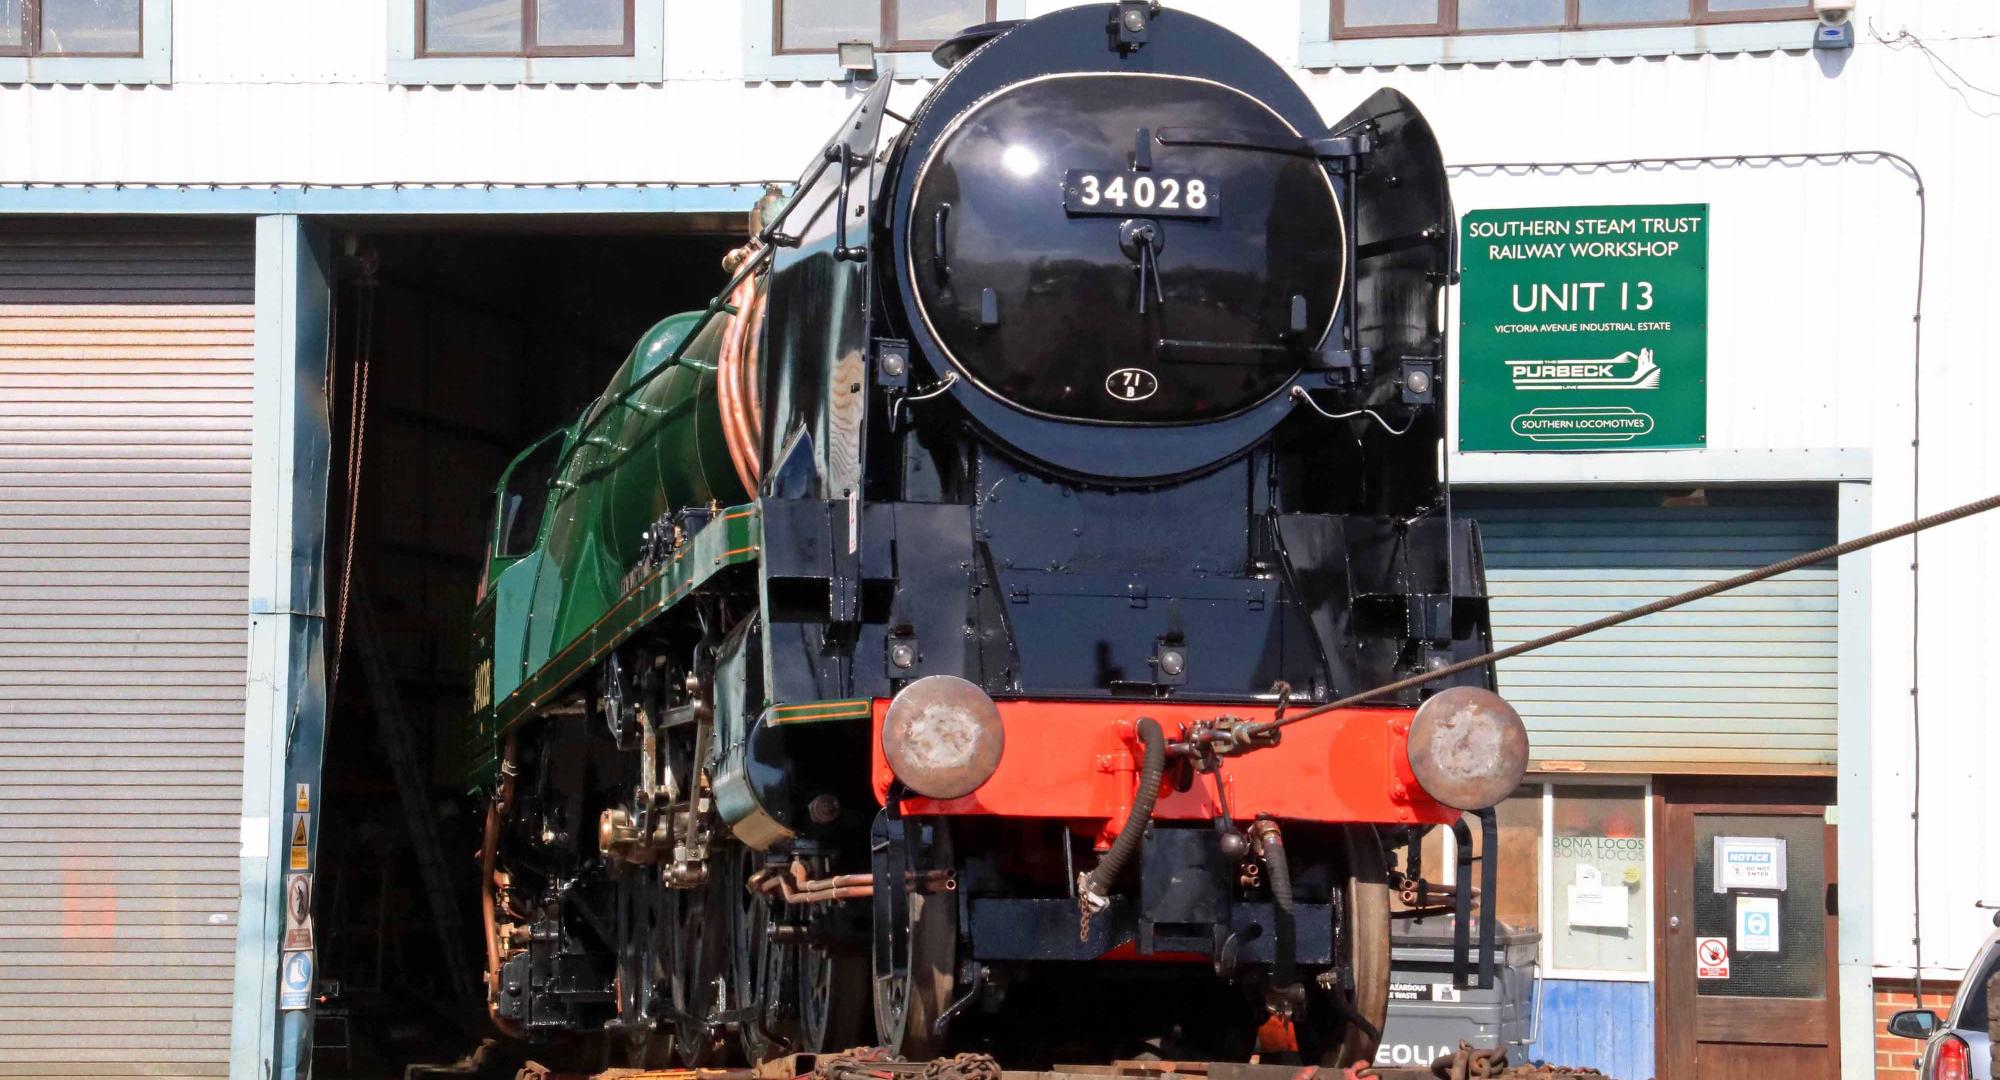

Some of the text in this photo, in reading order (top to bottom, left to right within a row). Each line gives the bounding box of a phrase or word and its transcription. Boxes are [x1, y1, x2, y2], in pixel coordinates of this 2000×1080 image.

[1081, 175, 1208, 210] 34028
[1469, 217, 1701, 237] SOUTHERN STEAM TRUST
[1489, 241, 1679, 260] RAILWAY WORKSHOP
[1512, 281, 1653, 313] UNIT 13
[1495, 321, 1671, 333] VICTORIA AVENUE INDUSTRIAL ESTATE
[1512, 364, 1614, 378] PURBECK
[1123, 372, 1141, 387] 71
[1126, 387, 1135, 398] B
[1522, 418, 1645, 429] SOUTHERN LOCOMOTIVES
[1553, 838, 1645, 850] BONA LOCOS
[1730, 852, 1770, 862] NOTICE
[1389, 984, 1427, 992] AZARDOUS
